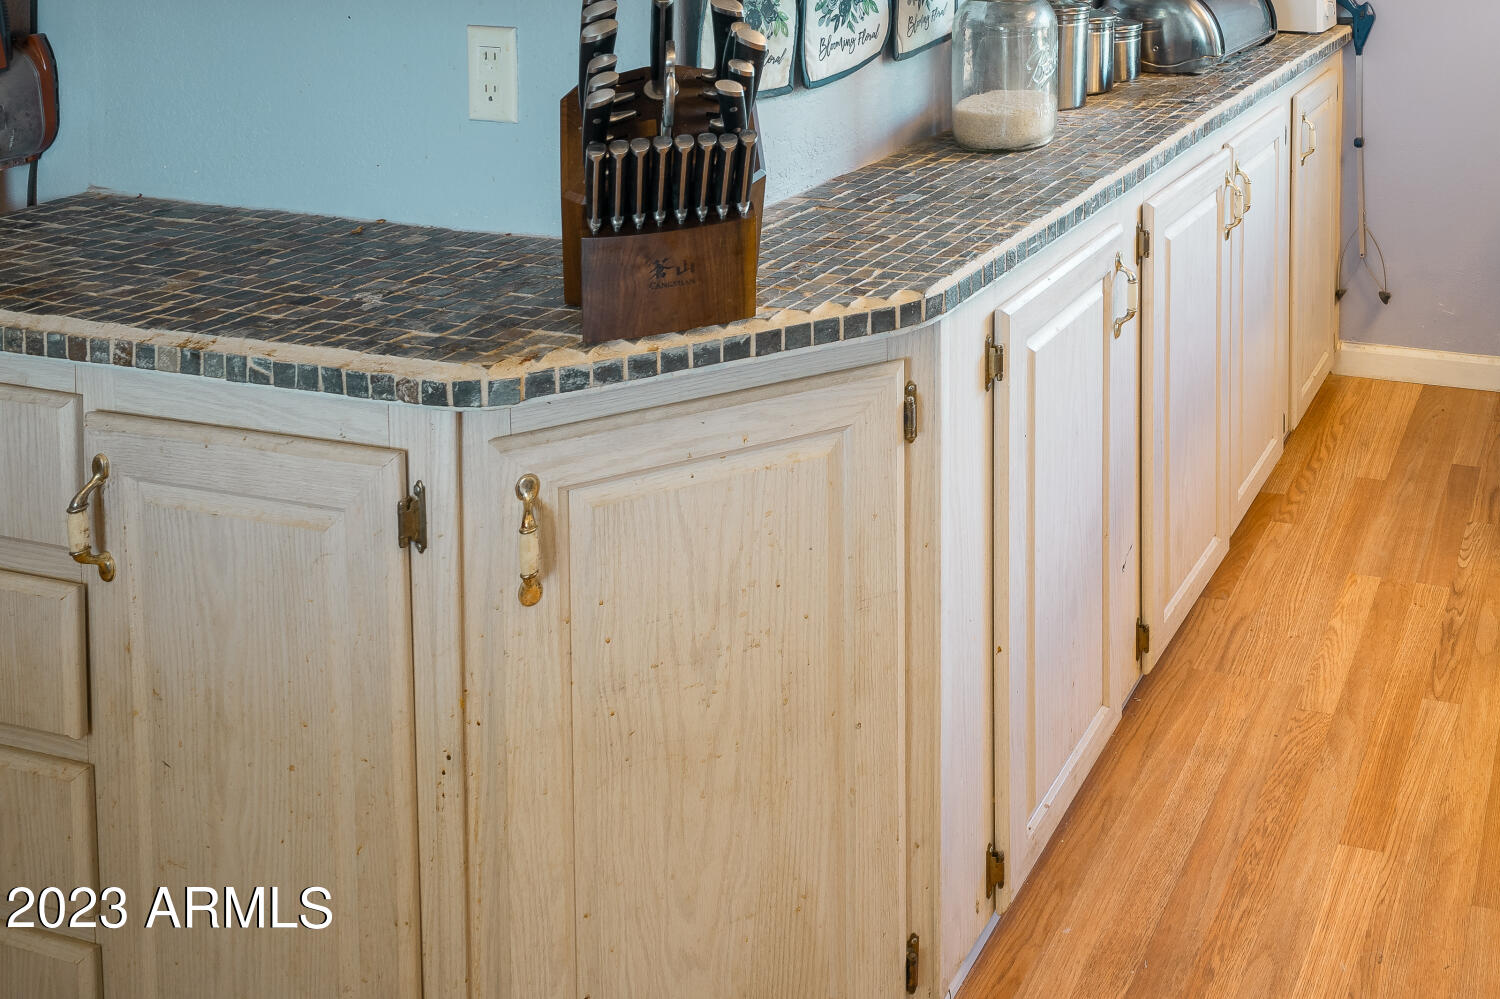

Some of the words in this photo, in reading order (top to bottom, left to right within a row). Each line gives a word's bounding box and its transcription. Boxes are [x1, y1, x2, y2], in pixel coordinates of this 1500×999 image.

[818, 34, 856, 61] Blooming
[857, 23, 881, 46] Floral
[764, 47, 787, 67] loral
